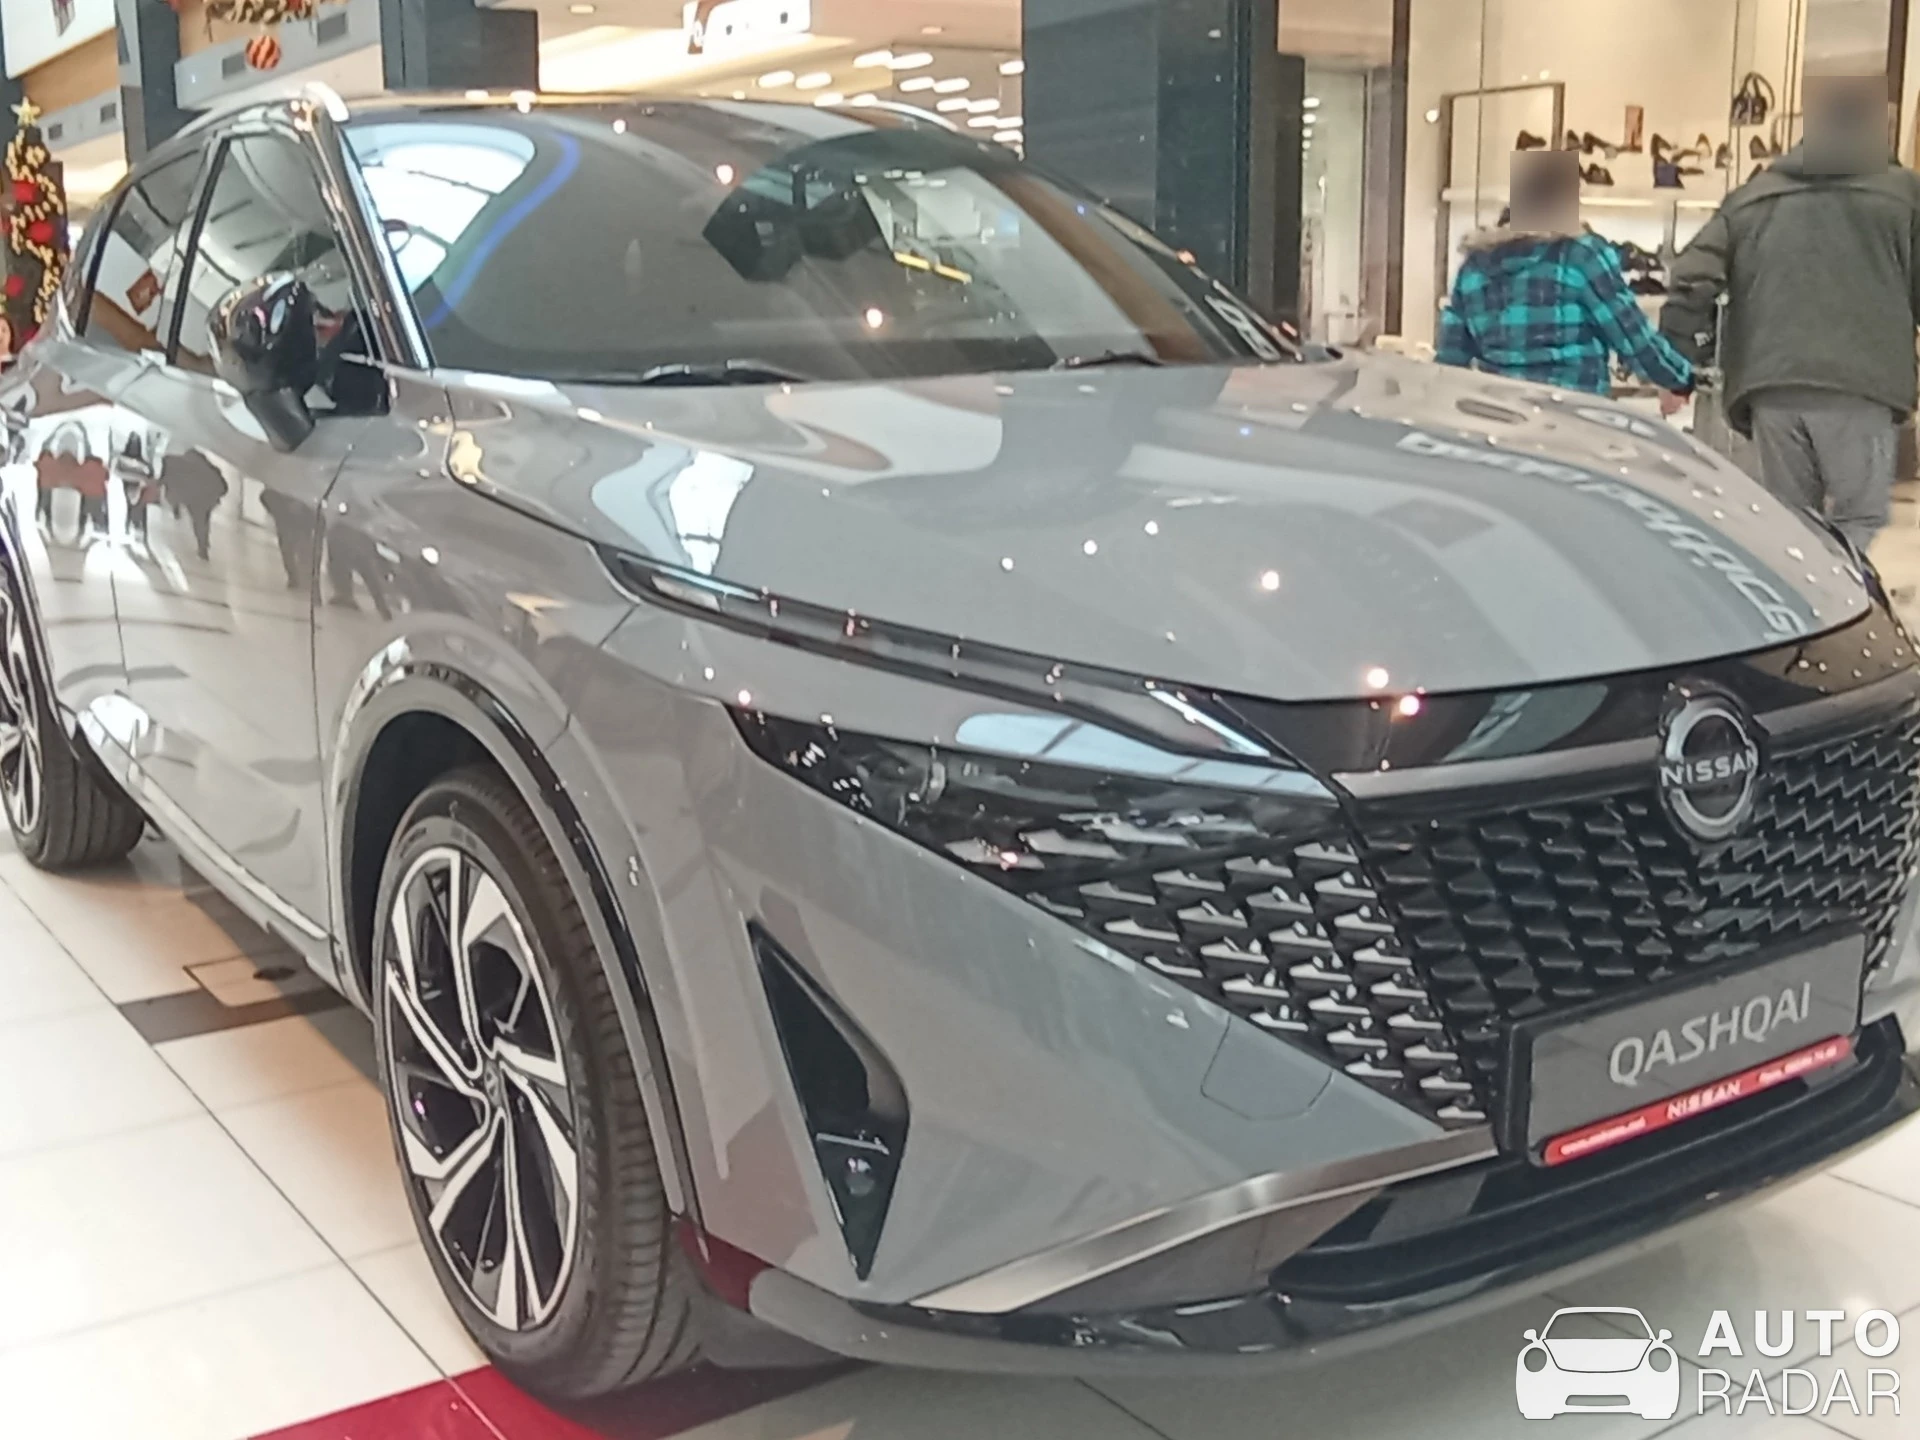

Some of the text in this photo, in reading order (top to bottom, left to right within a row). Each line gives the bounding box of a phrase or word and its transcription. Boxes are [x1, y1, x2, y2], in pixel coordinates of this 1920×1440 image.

[1660, 749, 1758, 787] NISSAN
[1608, 981, 1811, 1086] QASHQAI
[1666, 1081, 1742, 1119] NISSAN
